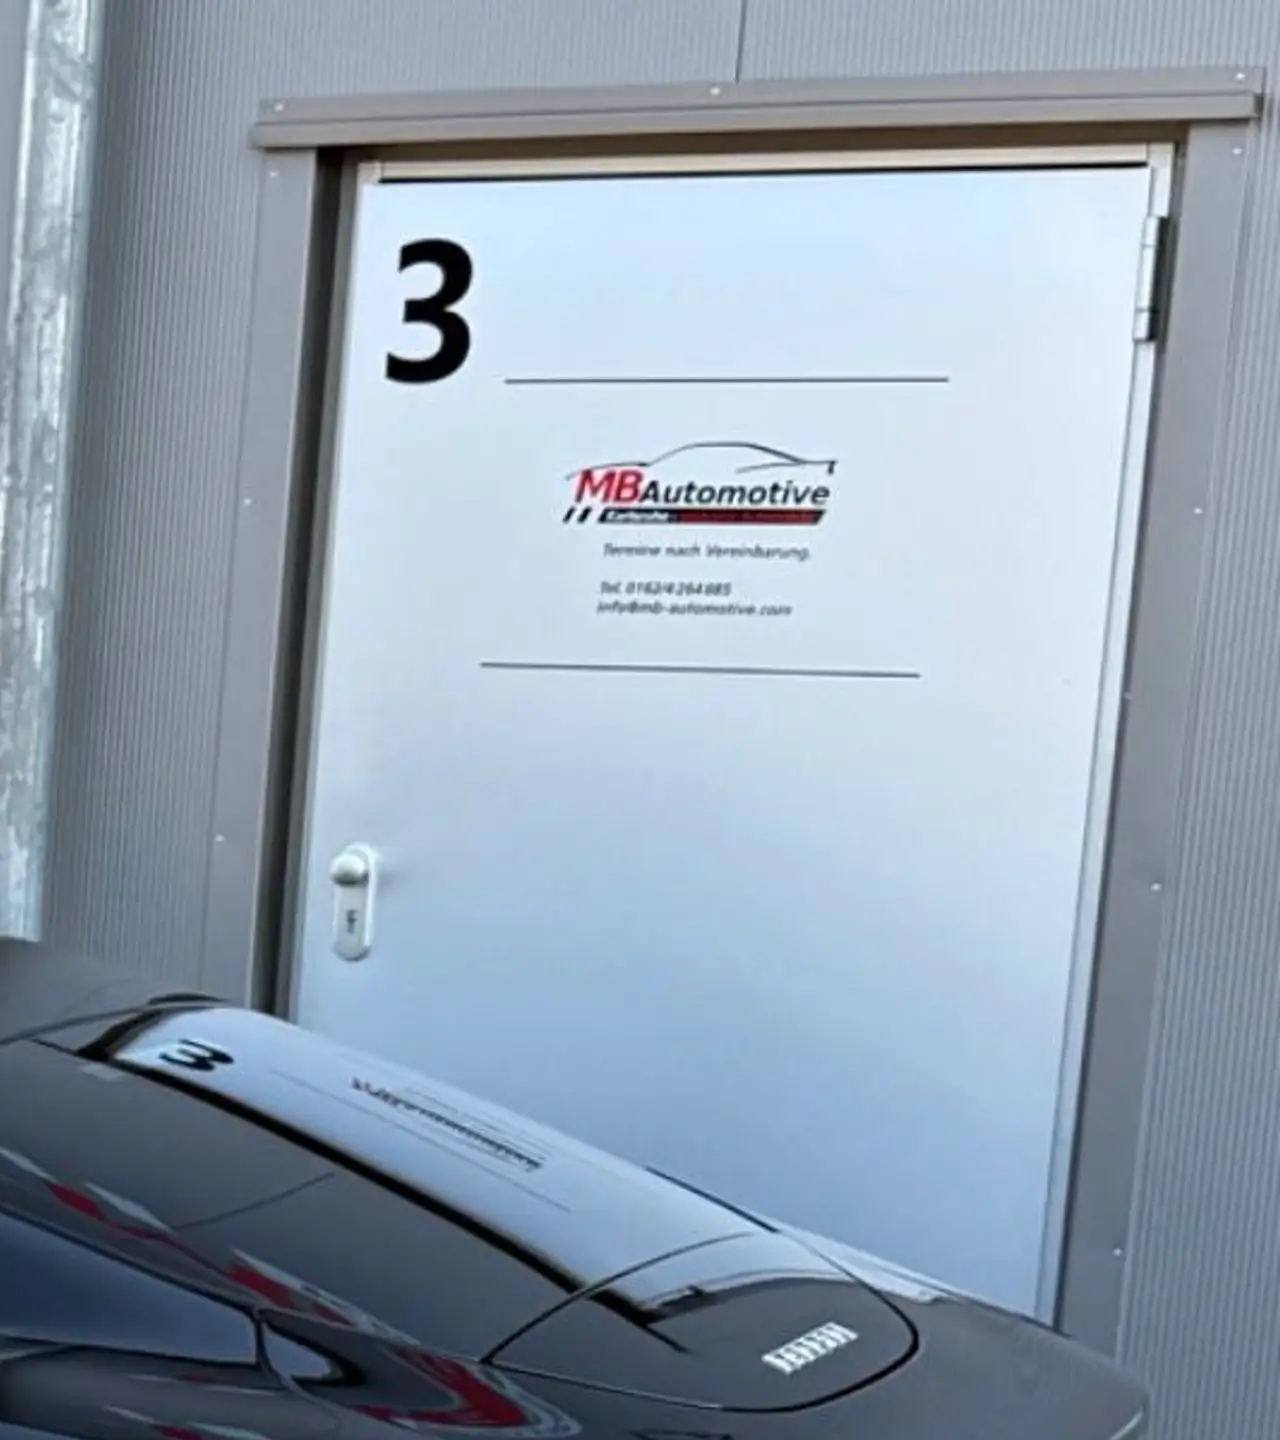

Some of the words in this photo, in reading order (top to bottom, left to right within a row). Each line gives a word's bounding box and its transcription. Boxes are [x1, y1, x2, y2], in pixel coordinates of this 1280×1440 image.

[385, 238, 474, 385] 3
[603, 543, 661, 558] Termine
[665, 544, 701, 558] nach
